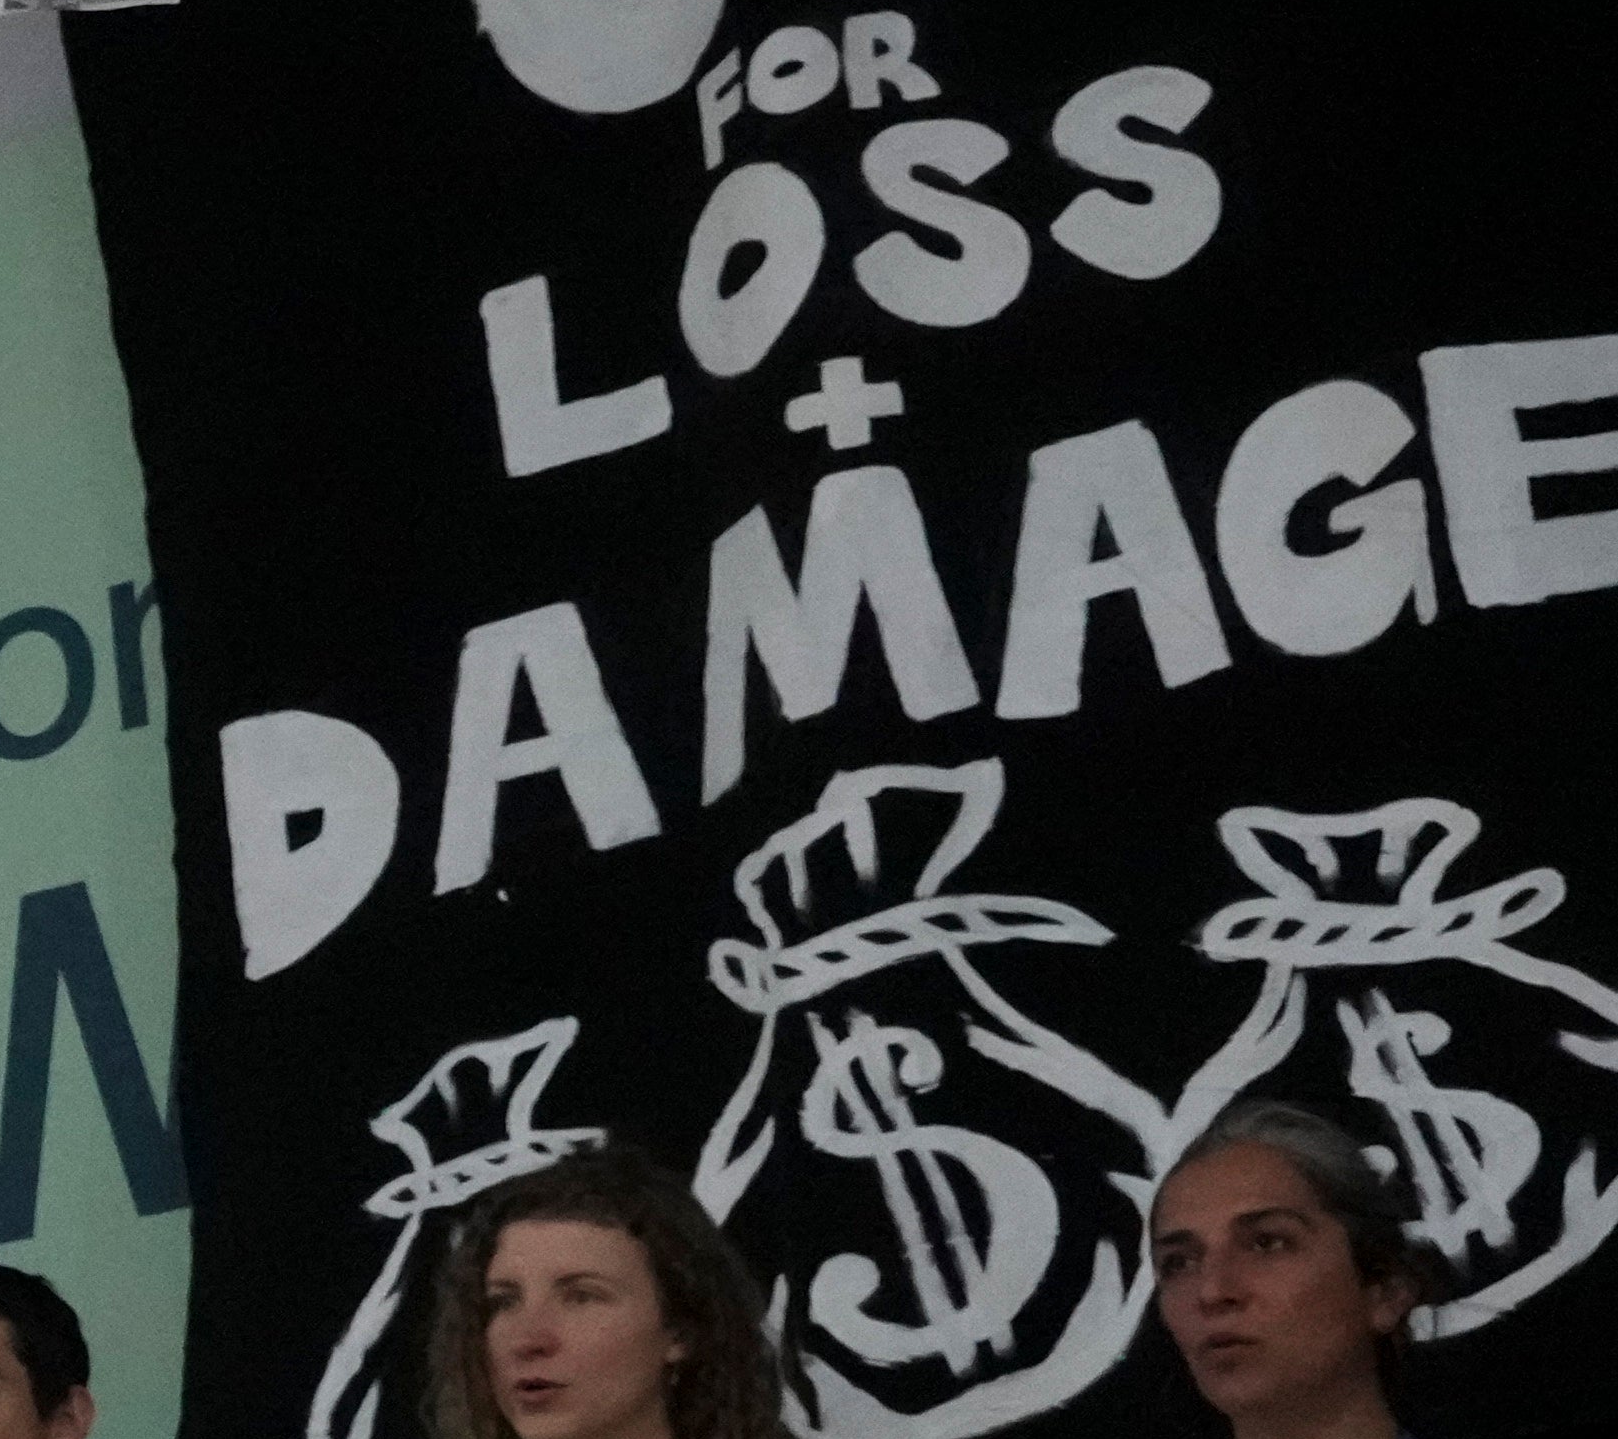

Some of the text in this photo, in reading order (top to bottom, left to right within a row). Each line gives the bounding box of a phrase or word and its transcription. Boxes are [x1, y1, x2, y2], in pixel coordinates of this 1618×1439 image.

[479, 65, 1223, 477] LOSS
[695, 10, 942, 168] FOR
[219, 334, 1618, 981] DAMAGE
